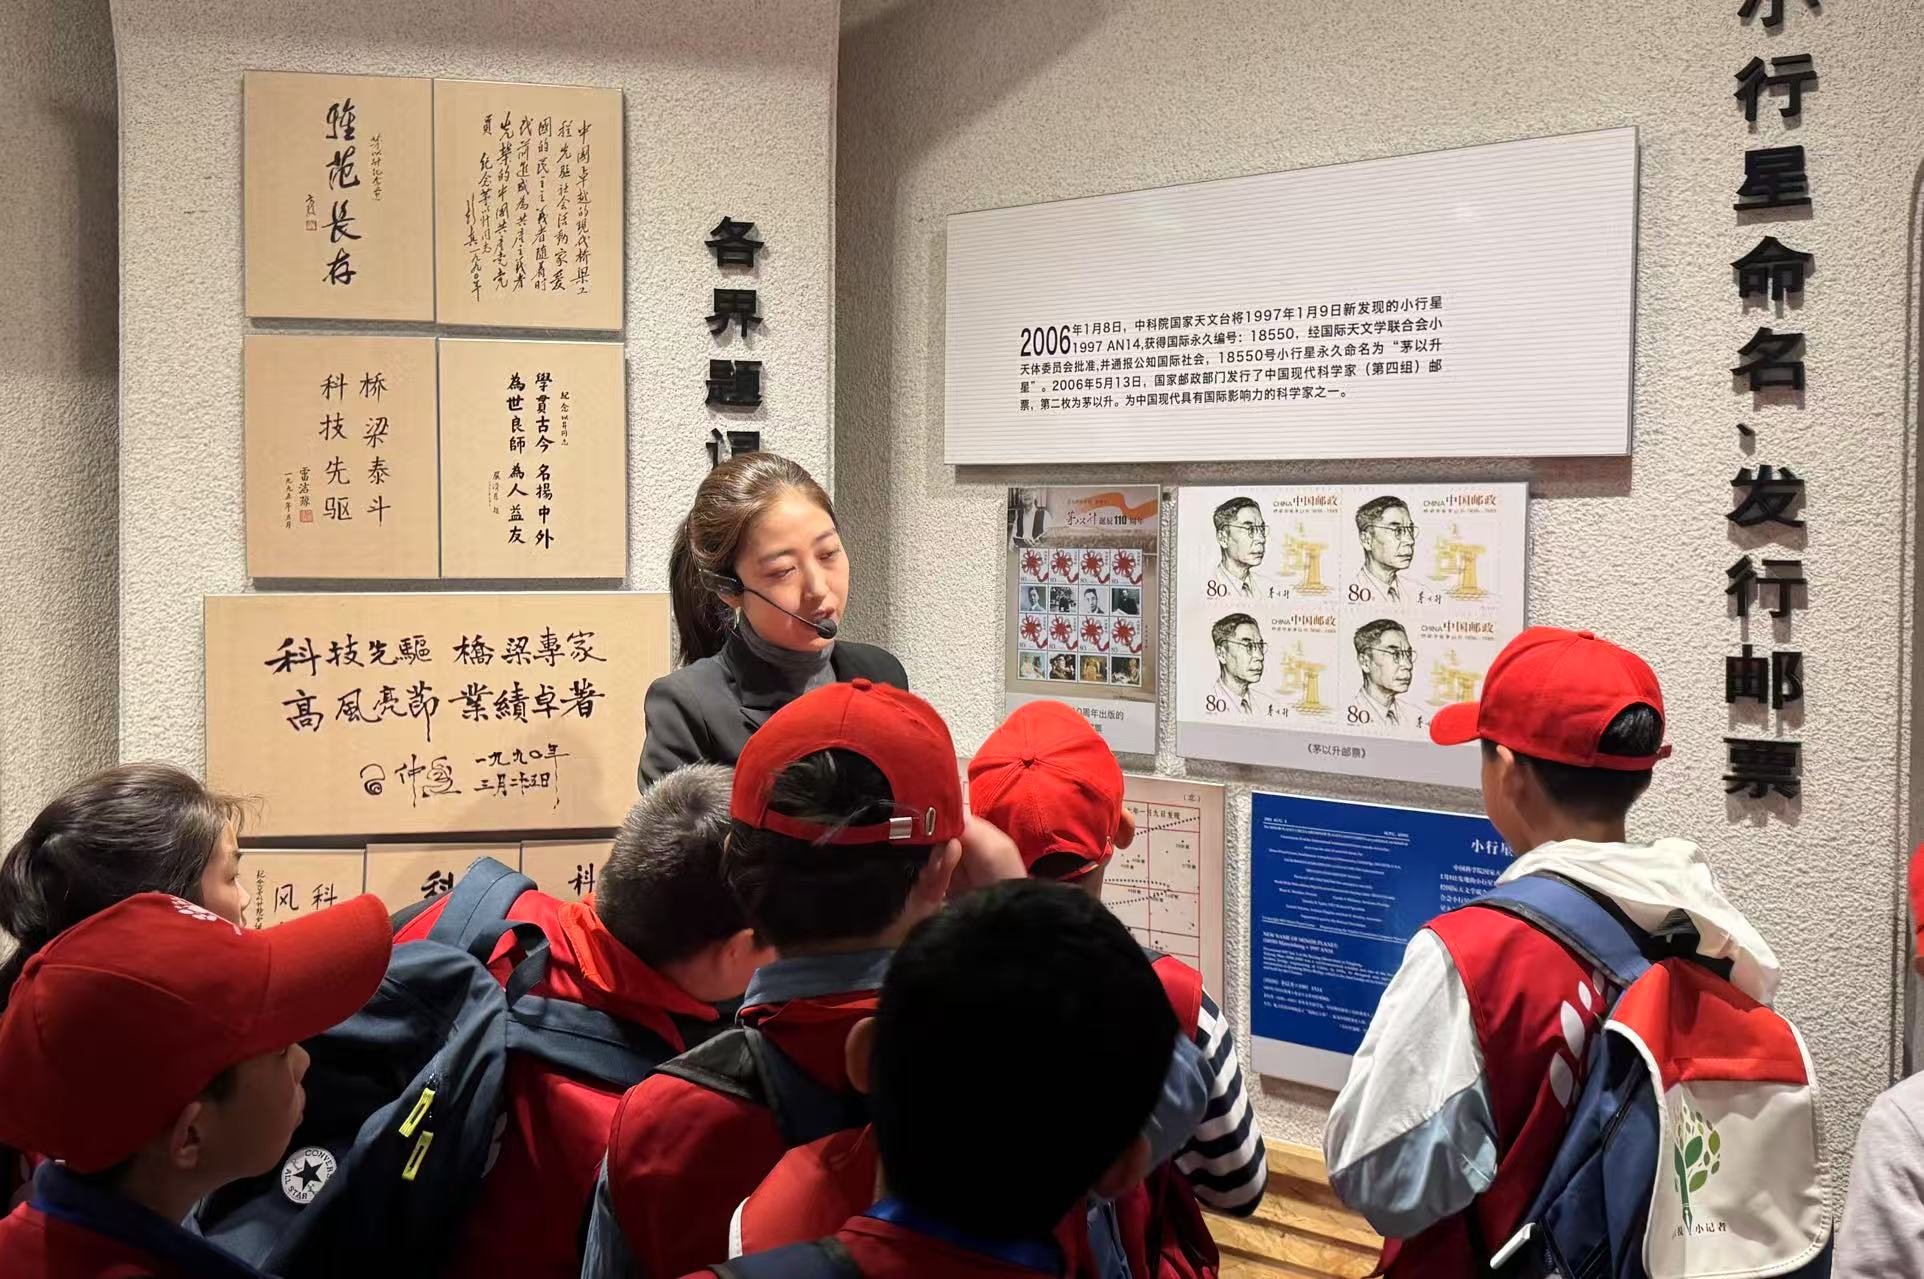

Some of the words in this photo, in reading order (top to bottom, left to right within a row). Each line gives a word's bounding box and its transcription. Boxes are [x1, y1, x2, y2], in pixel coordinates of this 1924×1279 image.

[1020, 325, 1071, 357] 2006
[1073, 340, 1103, 354] 1997
[318, 373, 353, 523] 科技先驱
[1293, 495, 1338, 507] 中国邮政
[1446, 494, 1497, 506] 中国邮政
[1206, 580, 1228, 597] 80
[1348, 584, 1371, 602] 80
[1291, 614, 1337, 627] 中国邮政
[1443, 621, 1495, 634] 中国邮政
[1206, 695, 1226, 713] 80
[1347, 706, 1370, 724] 80
[305, 1149, 334, 1178] CONVERS
[288, 1185, 308, 1200] STAR
